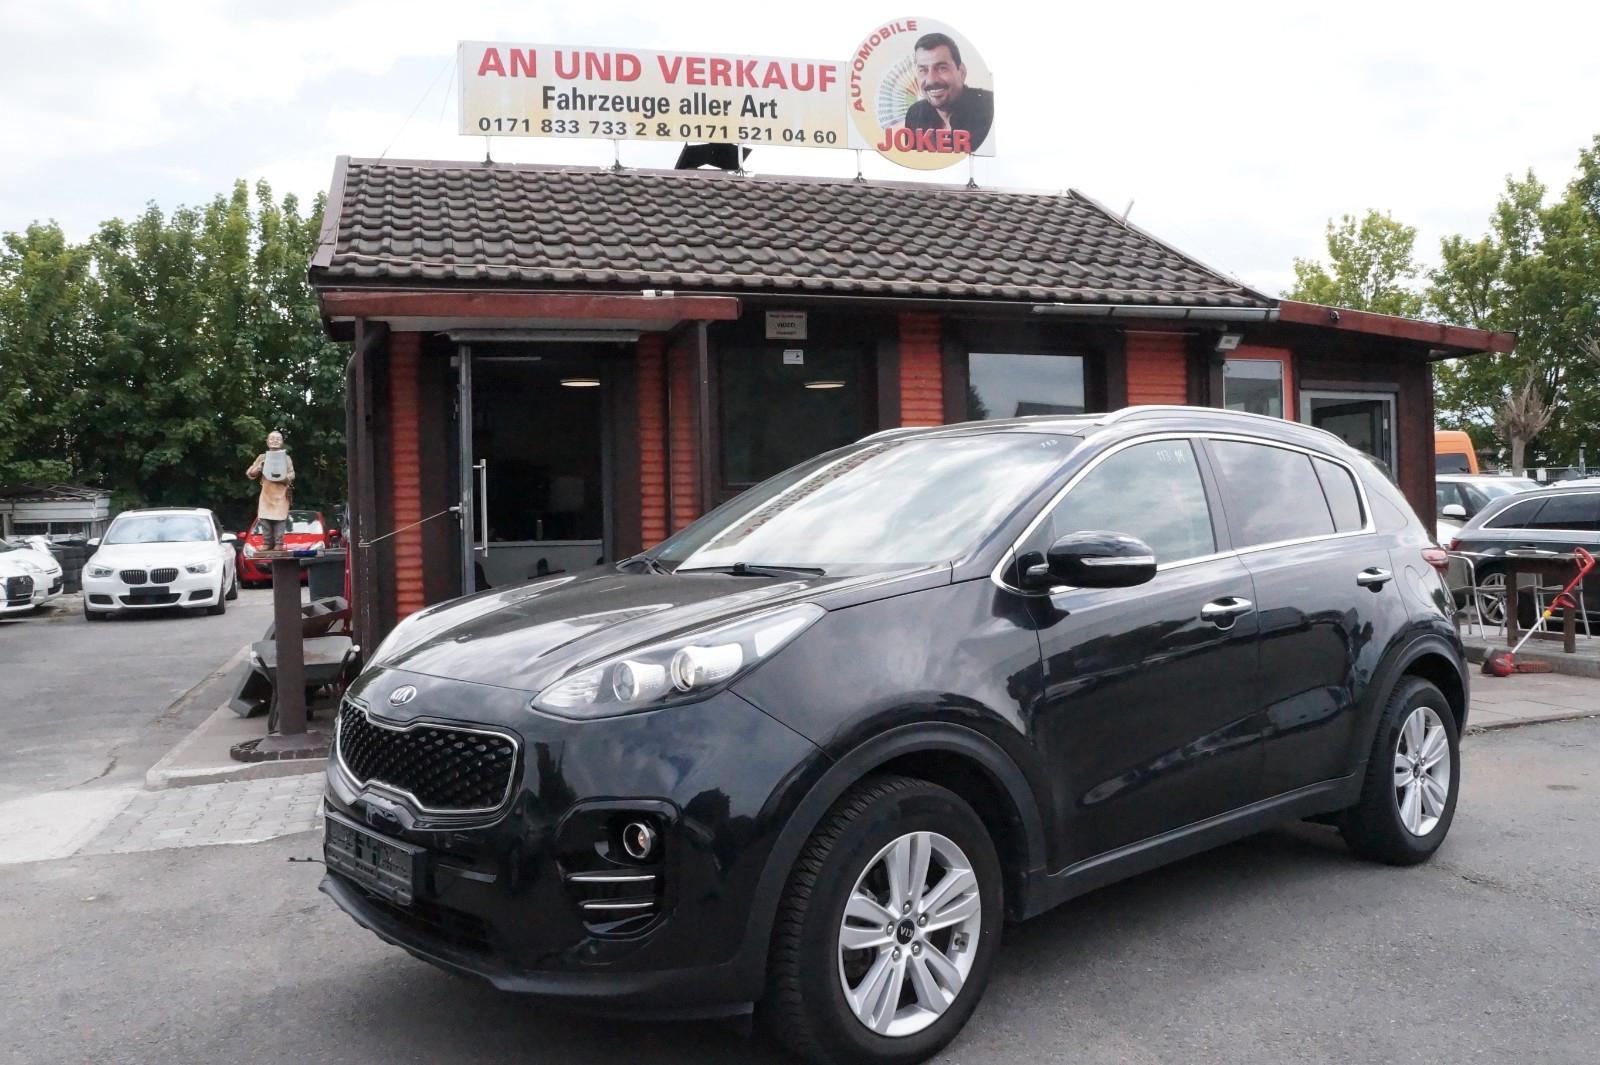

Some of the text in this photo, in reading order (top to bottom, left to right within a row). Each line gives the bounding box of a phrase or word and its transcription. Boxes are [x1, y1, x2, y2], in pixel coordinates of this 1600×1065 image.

[477, 47, 837, 93] AN UND VERKAUF
[850, 20, 918, 112] AUTOMOBILE
[542, 85, 778, 119] Fahrzeuge aller Art
[478, 116, 837, 144] 0171 833 733 2 & 0171 521 04 60
[876, 127, 973, 154] JOKER
